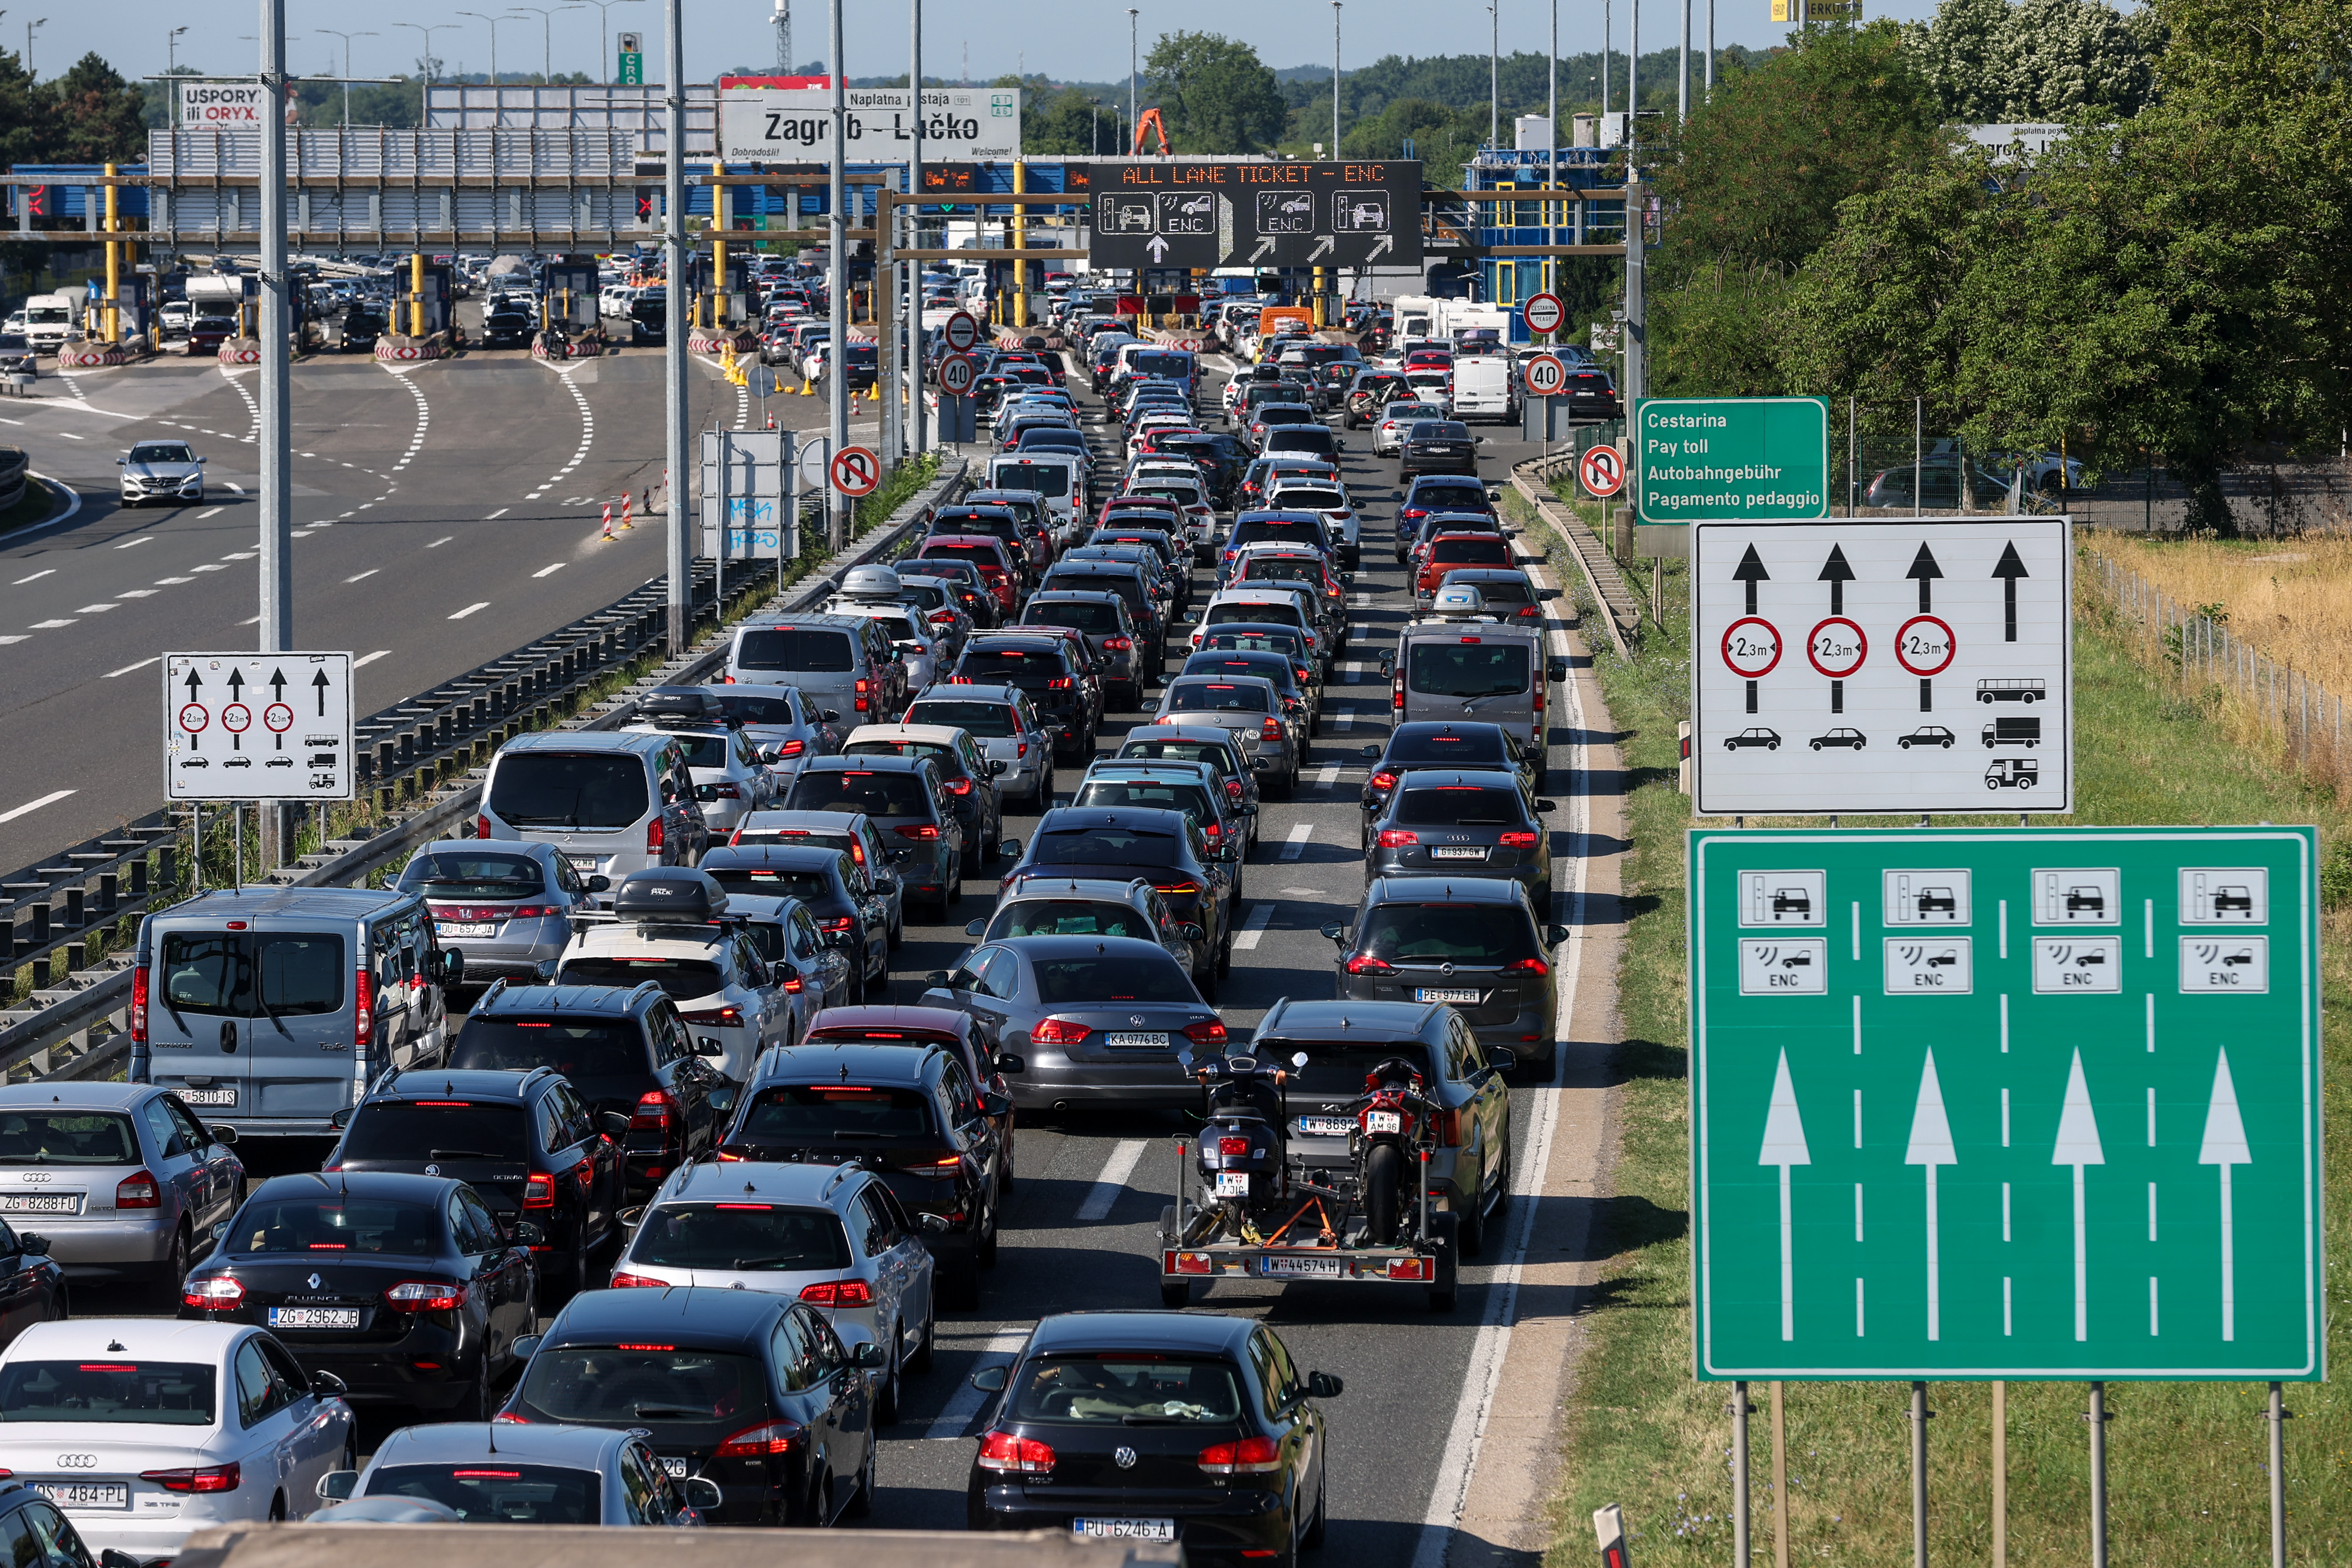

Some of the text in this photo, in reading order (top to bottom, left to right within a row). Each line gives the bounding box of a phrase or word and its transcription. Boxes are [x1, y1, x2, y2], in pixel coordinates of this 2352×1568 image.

[1808, 3, 1849, 15] ERKU
[186, 89, 260, 103] USPORY
[850, 93, 949, 105] Naplatna staja
[186, 106, 200, 120] ili
[765, 114, 861, 146] Zagrb
[731, 148, 780, 157] Dobrodošli!
[971, 147, 1013, 156] Welcome!
[1122, 168, 1162, 183] ALL
[1172, 168, 1226, 183] LANE
[1236, 166, 1312, 183] TICKET
[1344, 165, 1385, 182] ENC
[1168, 218, 1204, 232] ENC
[1268, 218, 1304, 231] ENC
[948, 365, 967, 383] 40
[1534, 366, 1556, 385] 40
[1648, 413, 1727, 427] Cestarina
[1648, 439, 1709, 457] Pay toll
[1648, 464, 1782, 483] Autobahngebühr
[1649, 490, 1820, 510] Pagamento pedaggio
[1248, 730, 1257, 738] HR
[1452, 848, 1466, 856] 937
[442, 925, 453, 933] DU
[1769, 973, 1799, 987] ENC
[1915, 973, 1944, 987] ENC
[2063, 972, 2093, 985] ENC
[2210, 972, 2240, 985] ENC
[1424, 990, 1476, 1000] PE 977 EH
[1111, 1034, 1166, 1045] KA 0776 BC
[1309, 1118, 1317, 1129] W
[1387, 1123, 1397, 1131] 96
[1227, 1175, 1234, 1185] W
[1221, 1185, 1227, 1194] 7
[5, 1196, 20, 1209] ZG
[1271, 1259, 1280, 1272] W
[279, 1309, 296, 1323] ZG
[1086, 1520, 1168, 1537] PU 6246-A
